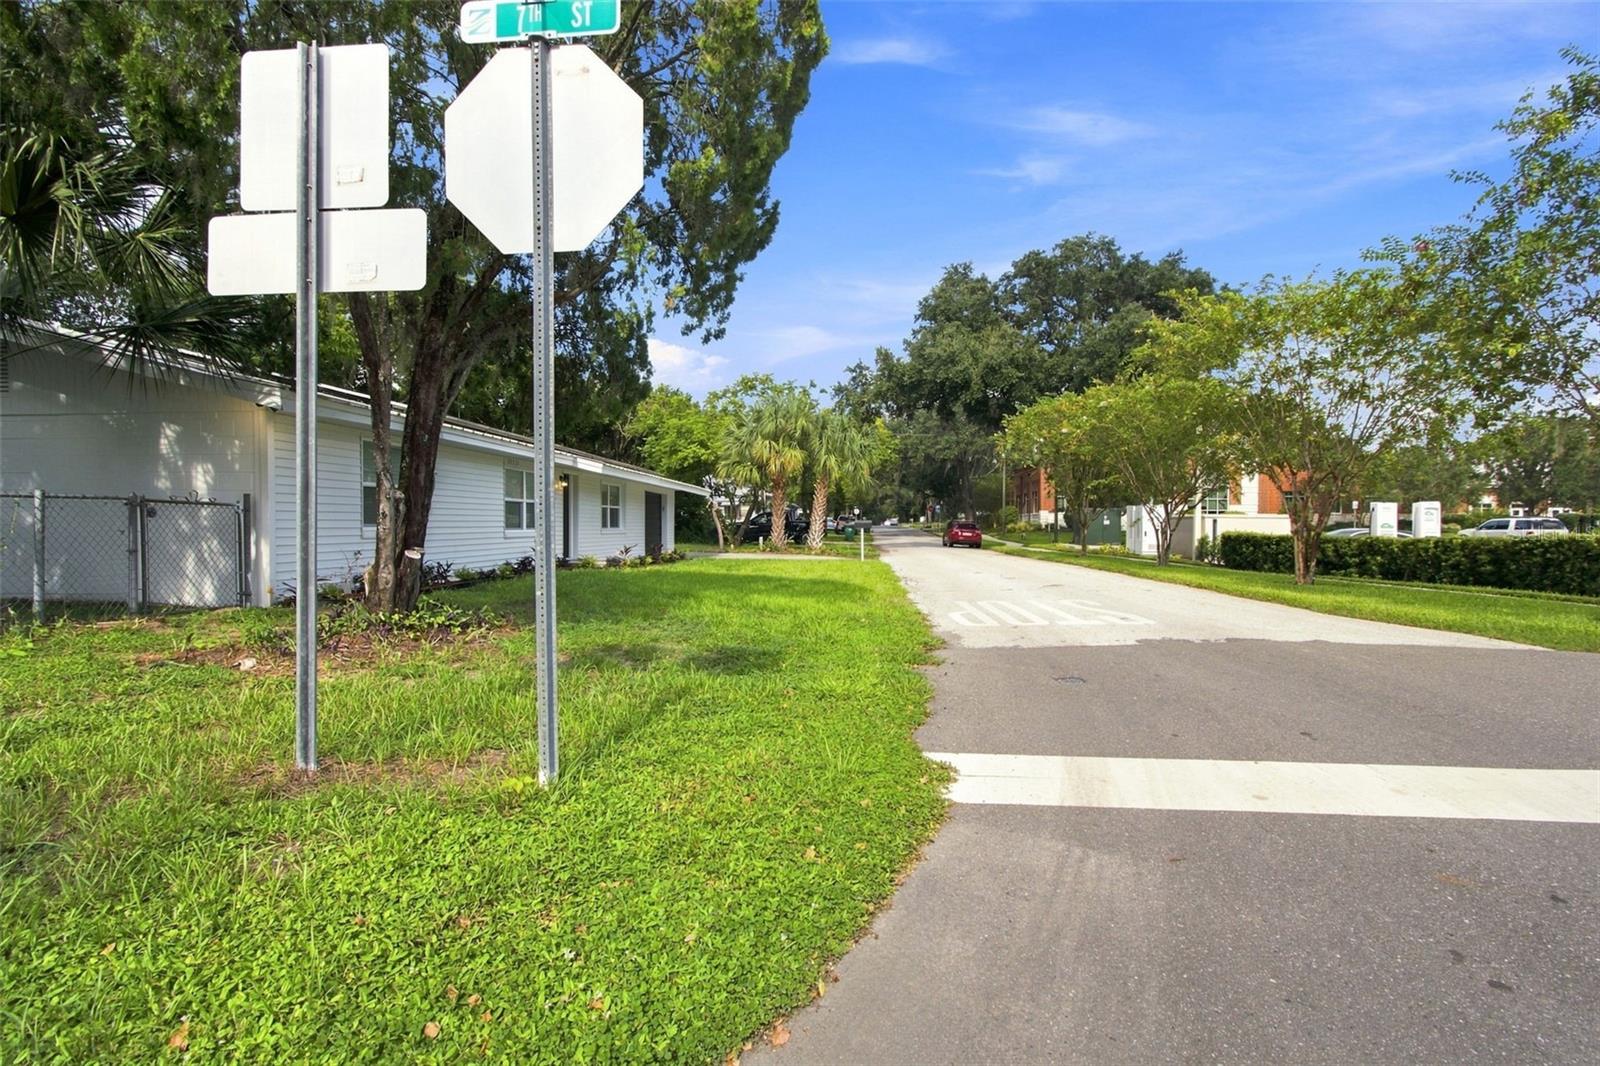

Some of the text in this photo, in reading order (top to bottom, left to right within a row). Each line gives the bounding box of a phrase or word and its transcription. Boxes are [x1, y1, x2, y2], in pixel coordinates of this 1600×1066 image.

[516, 1, 593, 33] 7TH ST
[948, 599, 1156, 626] STOP
